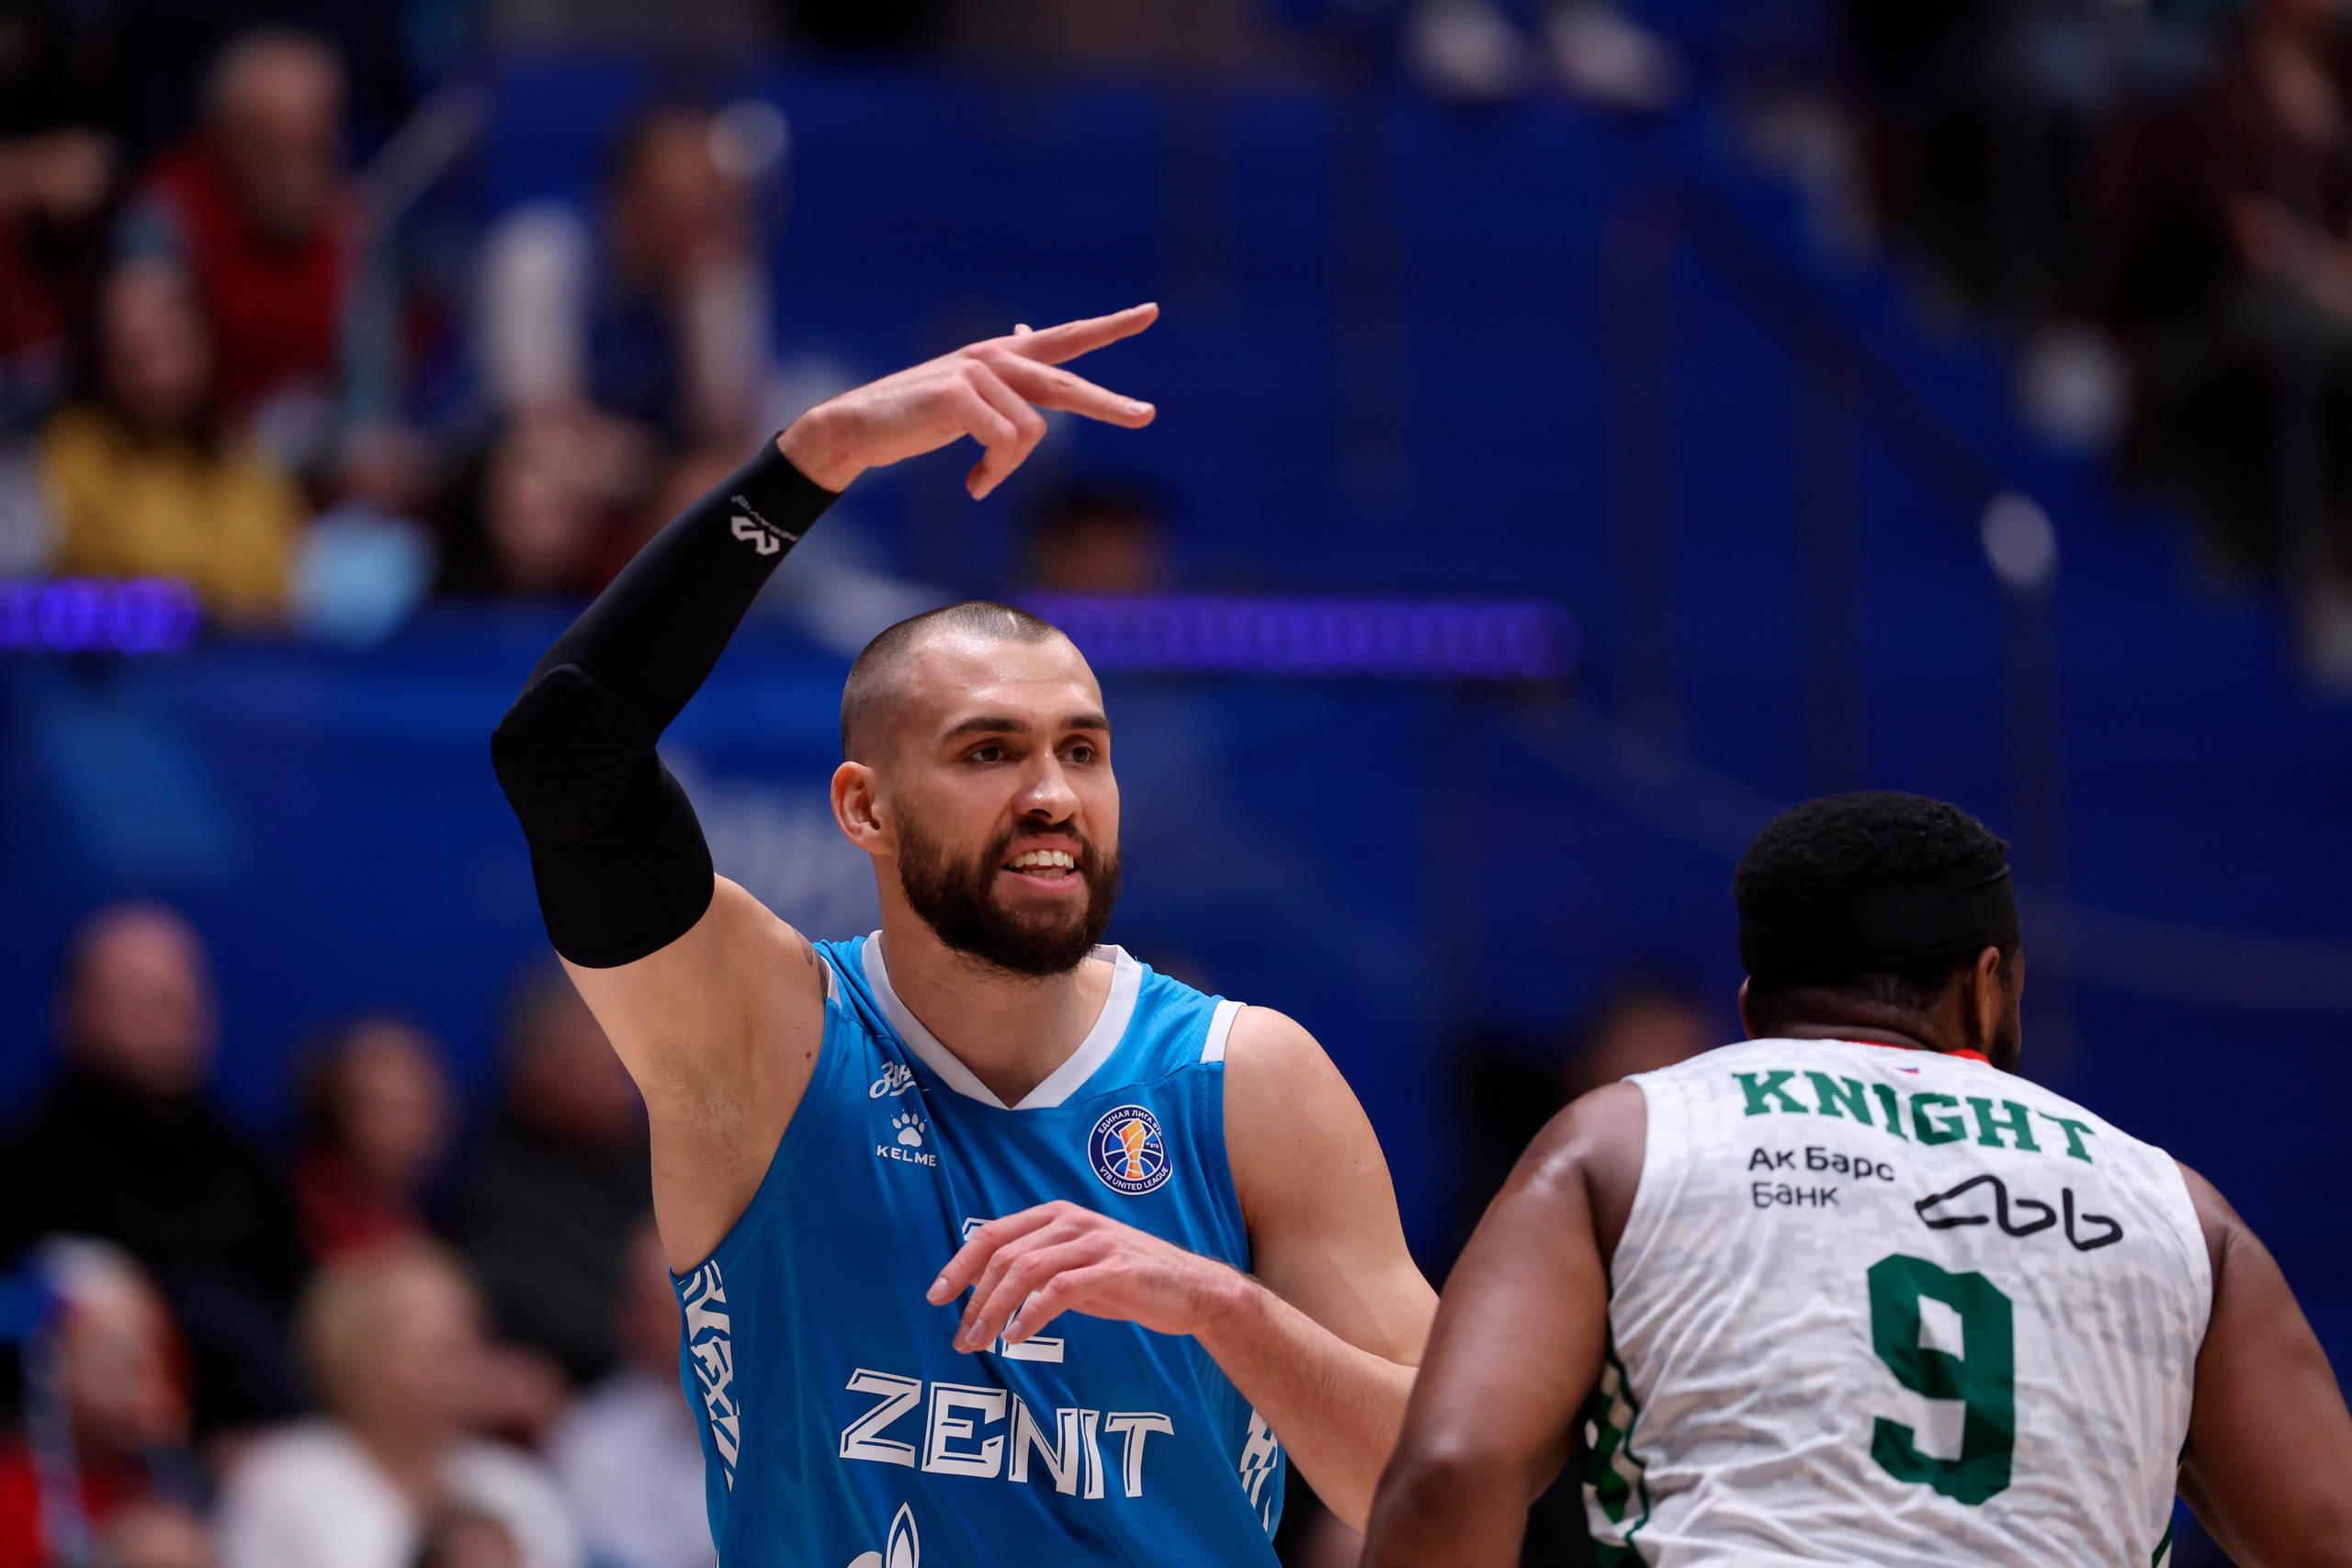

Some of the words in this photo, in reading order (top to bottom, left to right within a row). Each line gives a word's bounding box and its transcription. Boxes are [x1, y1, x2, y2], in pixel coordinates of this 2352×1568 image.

[1097, 1110, 1130, 1134] ЕДИНАЯ
[1131, 1110, 1152, 1123] ЛИГА
[1732, 1069, 2095, 1164] KNIGHT
[876, 1145, 937, 1167] KELME
[1747, 1147, 1796, 1172] Ак
[1804, 1145, 1895, 1182] Барс
[1100, 1165, 1113, 1181] VTB
[1112, 1179, 1143, 1190] UNITED
[1144, 1166, 1169, 1189] LEAGUE
[1751, 1181, 1840, 1209] Банк
[1867, 1253, 2017, 1506] 9
[840, 1368, 1173, 1500] ZENIT
